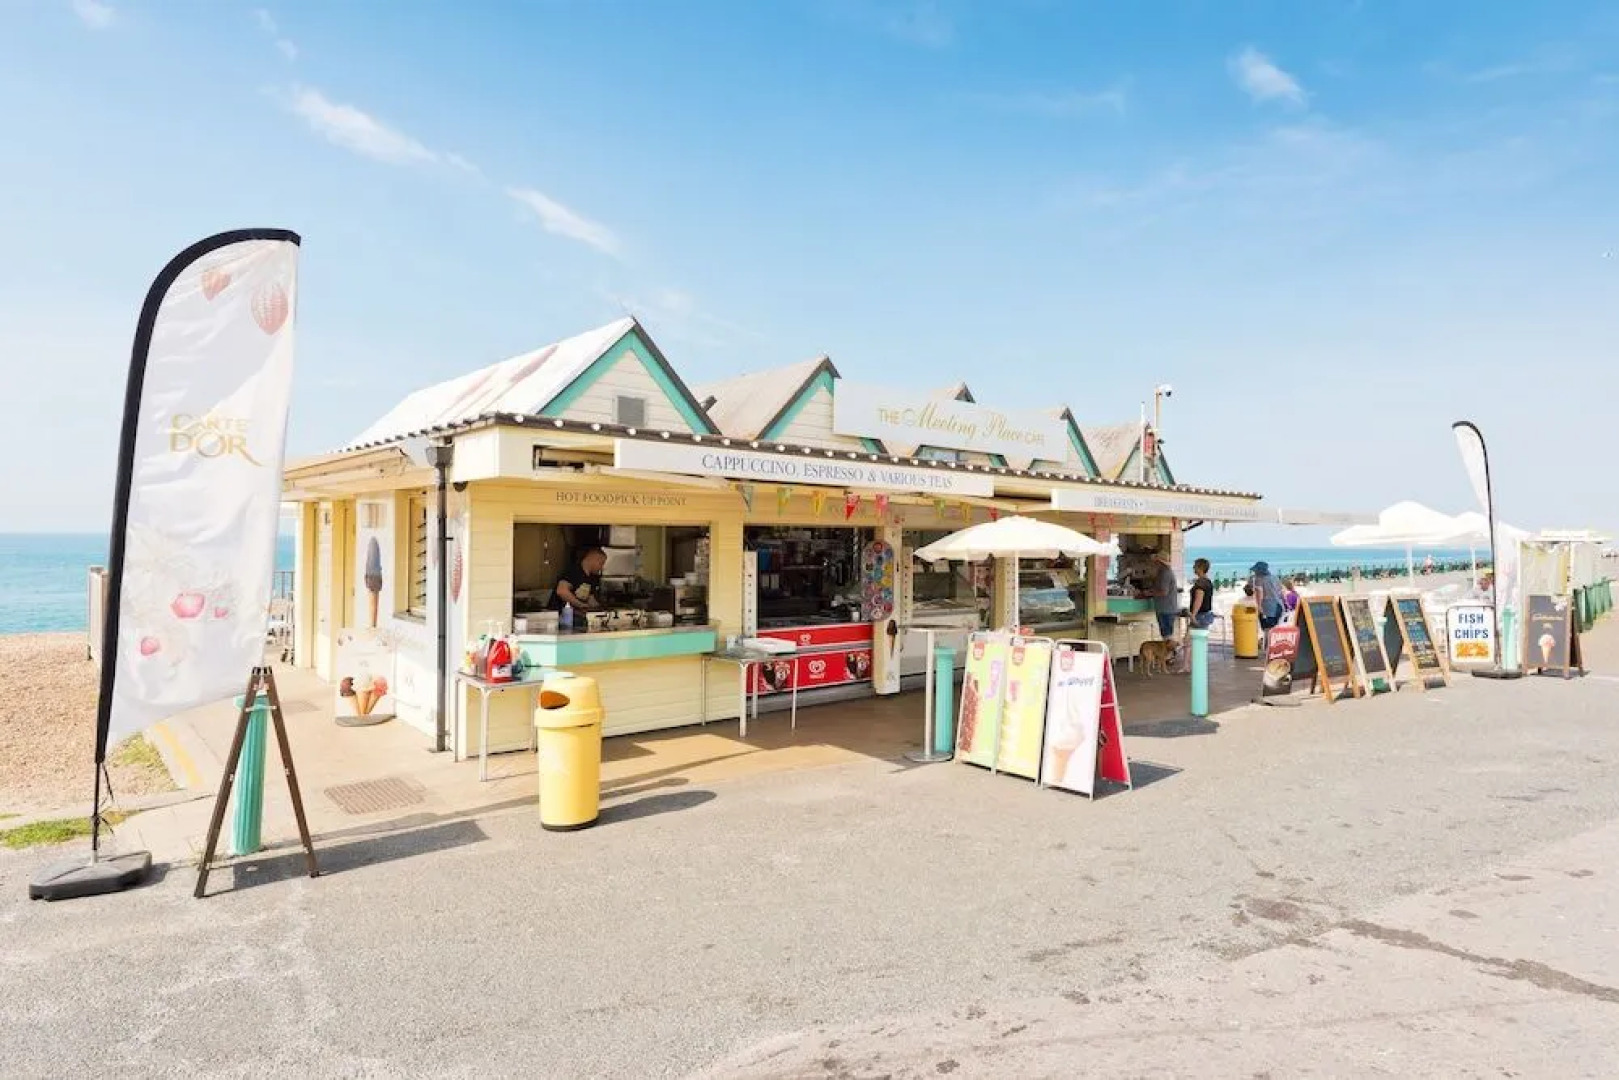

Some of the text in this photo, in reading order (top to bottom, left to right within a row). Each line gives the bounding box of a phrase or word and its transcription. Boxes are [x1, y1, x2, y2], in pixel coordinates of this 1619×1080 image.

[878, 407, 900, 425] THE
[902, 401, 977, 439] Meeting
[982, 410, 1024, 441] Place
[701, 453, 953, 489] CAPPUCCINO, ESPRESSO & VARIOUS TEAS
[556, 491, 580, 503] HOT
[582, 492, 614, 505] FOOD
[615, 493, 640, 506] PICK
[1458, 613, 1484, 624] FISH
[1454, 628, 1489, 639] CHIPS
